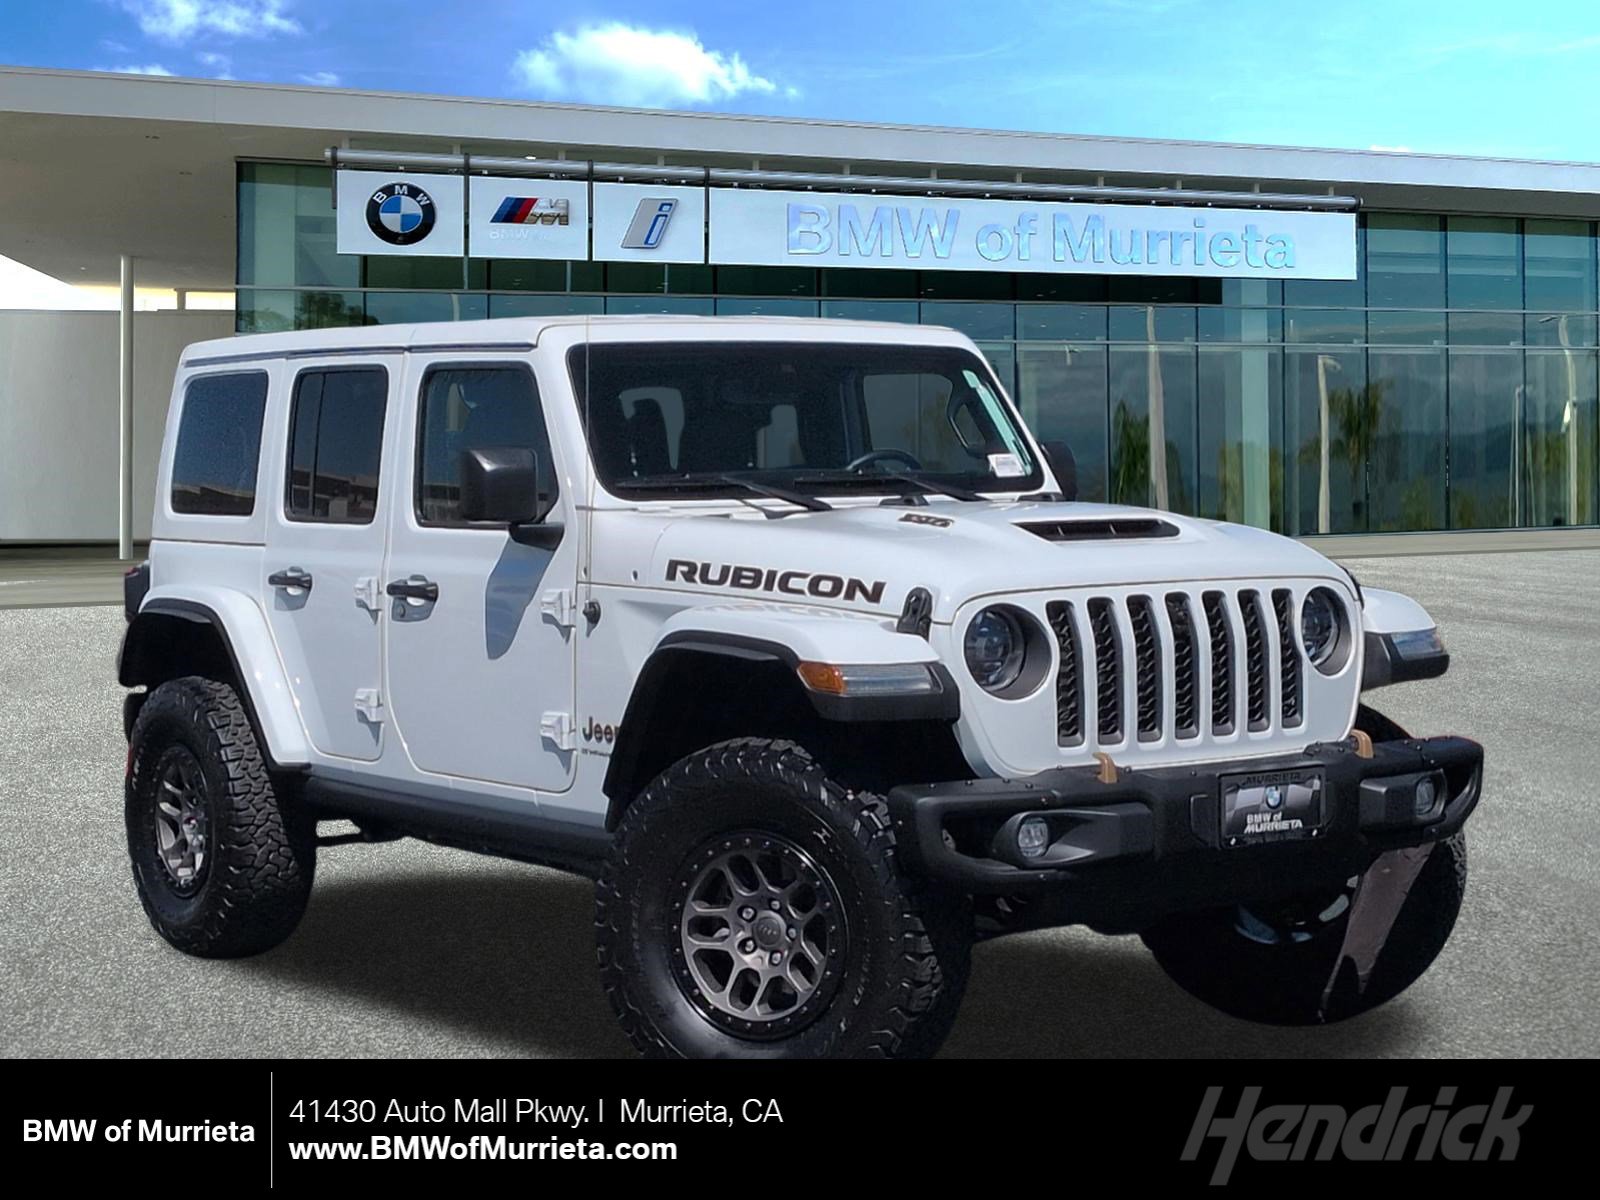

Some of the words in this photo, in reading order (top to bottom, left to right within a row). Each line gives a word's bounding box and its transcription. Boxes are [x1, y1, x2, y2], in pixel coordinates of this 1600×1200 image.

[372, 185, 430, 206] BMW
[786, 202, 961, 259] BMW
[975, 211, 1039, 263] of
[1051, 211, 1297, 270] Murrieta
[665, 558, 887, 604] RUBICON
[1243, 818, 1303, 834] MURRIETA
[1247, 812, 1272, 824] BMW
[1273, 811, 1283, 822] of
